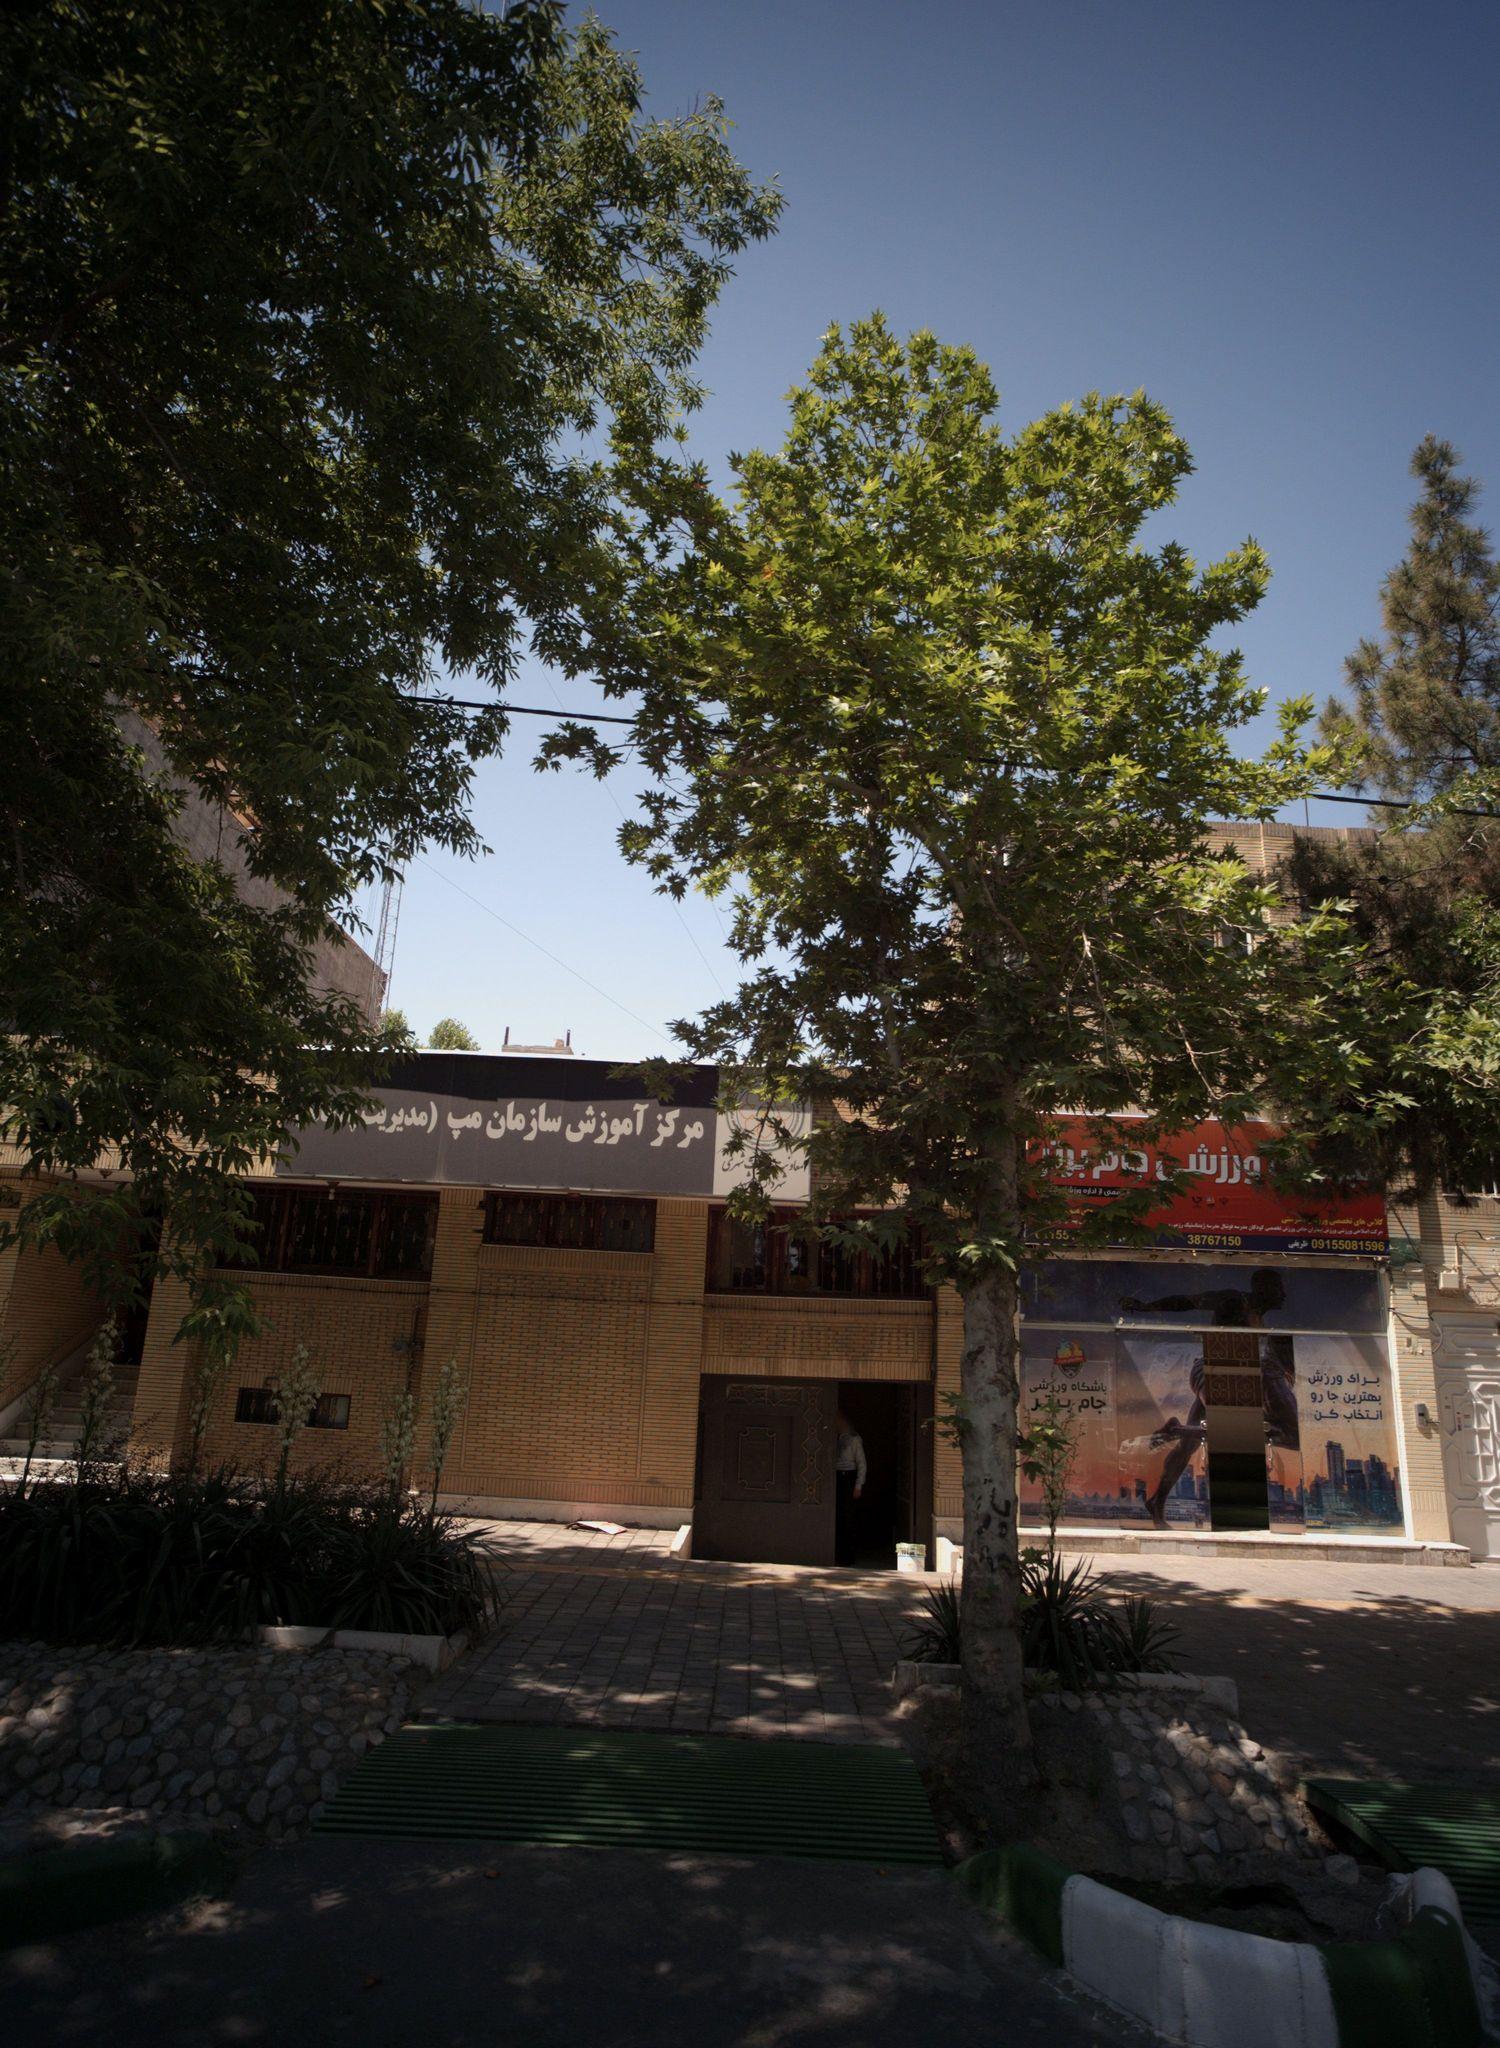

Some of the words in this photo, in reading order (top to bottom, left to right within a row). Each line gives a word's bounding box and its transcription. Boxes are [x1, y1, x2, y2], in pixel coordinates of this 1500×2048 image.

[447, 1110, 482, 1140] مپ
[486, 1101, 562, 1140] سازمان
[565, 1103, 649, 1144] آموزش
[650, 1108, 704, 1148] مرکز
[1155, 1143, 1262, 1185] ورزشی
[1187, 1234, 1242, 1247] 38767150
[1311, 1238, 1385, 1252] 09155081596
[1308, 1369, 1343, 1385] ورزش
[1347, 1373, 1380, 1387] برای
[1071, 1380, 1107, 1395] باشگاه
[1078, 1396, 1106, 1414] جام
[1343, 1391, 1381, 1405] بهترین
[1314, 1408, 1339, 1421] کن
[1343, 1409, 1383, 1423] انتخاب
